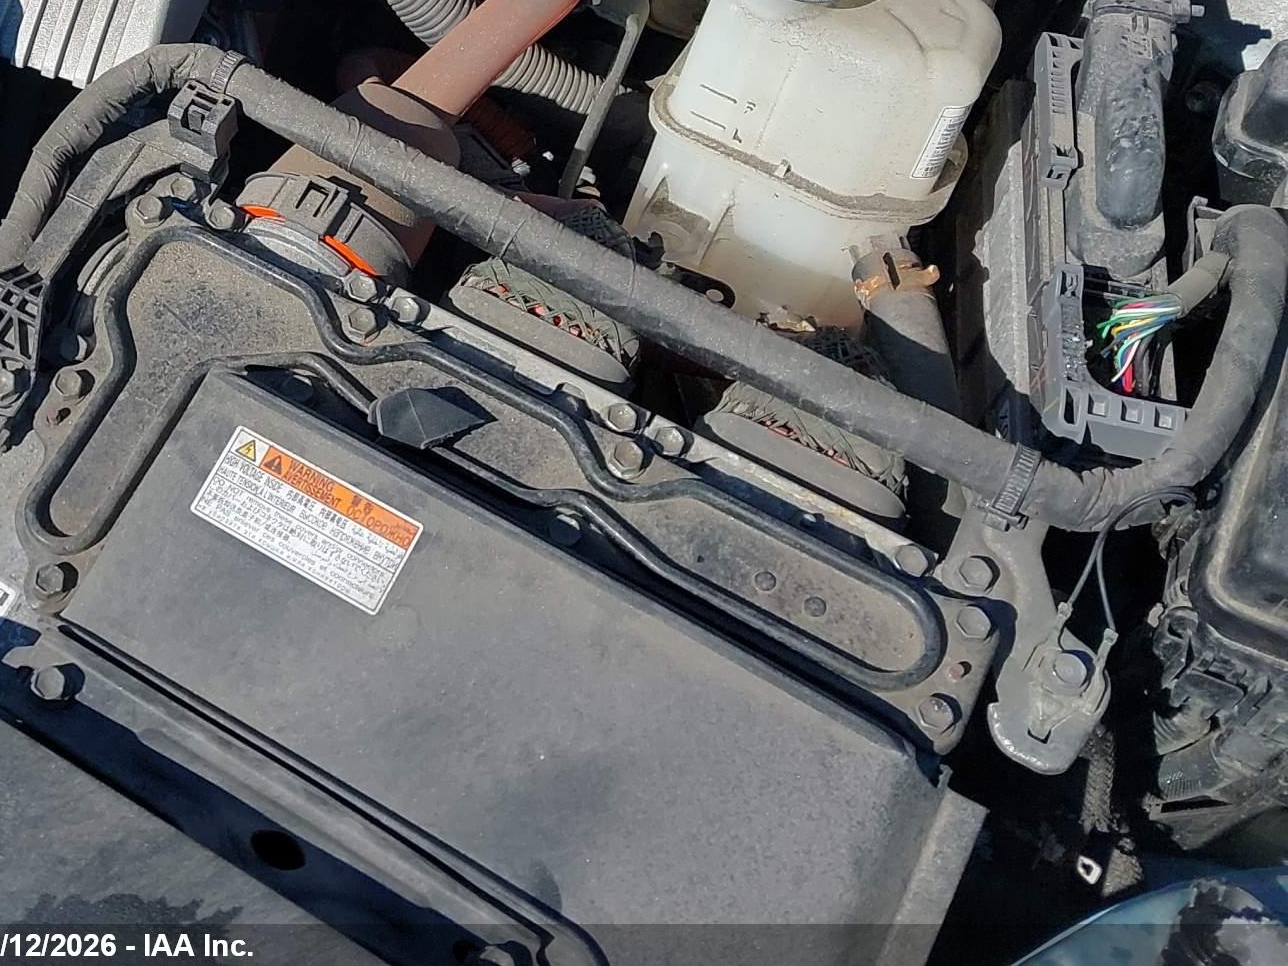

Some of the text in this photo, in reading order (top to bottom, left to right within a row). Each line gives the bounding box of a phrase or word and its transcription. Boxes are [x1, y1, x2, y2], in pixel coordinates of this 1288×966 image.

[237, 461, 265, 482] VOLTAGE
[280, 468, 343, 509] AVERTISSEMENT
[286, 458, 336, 493] WARNING
